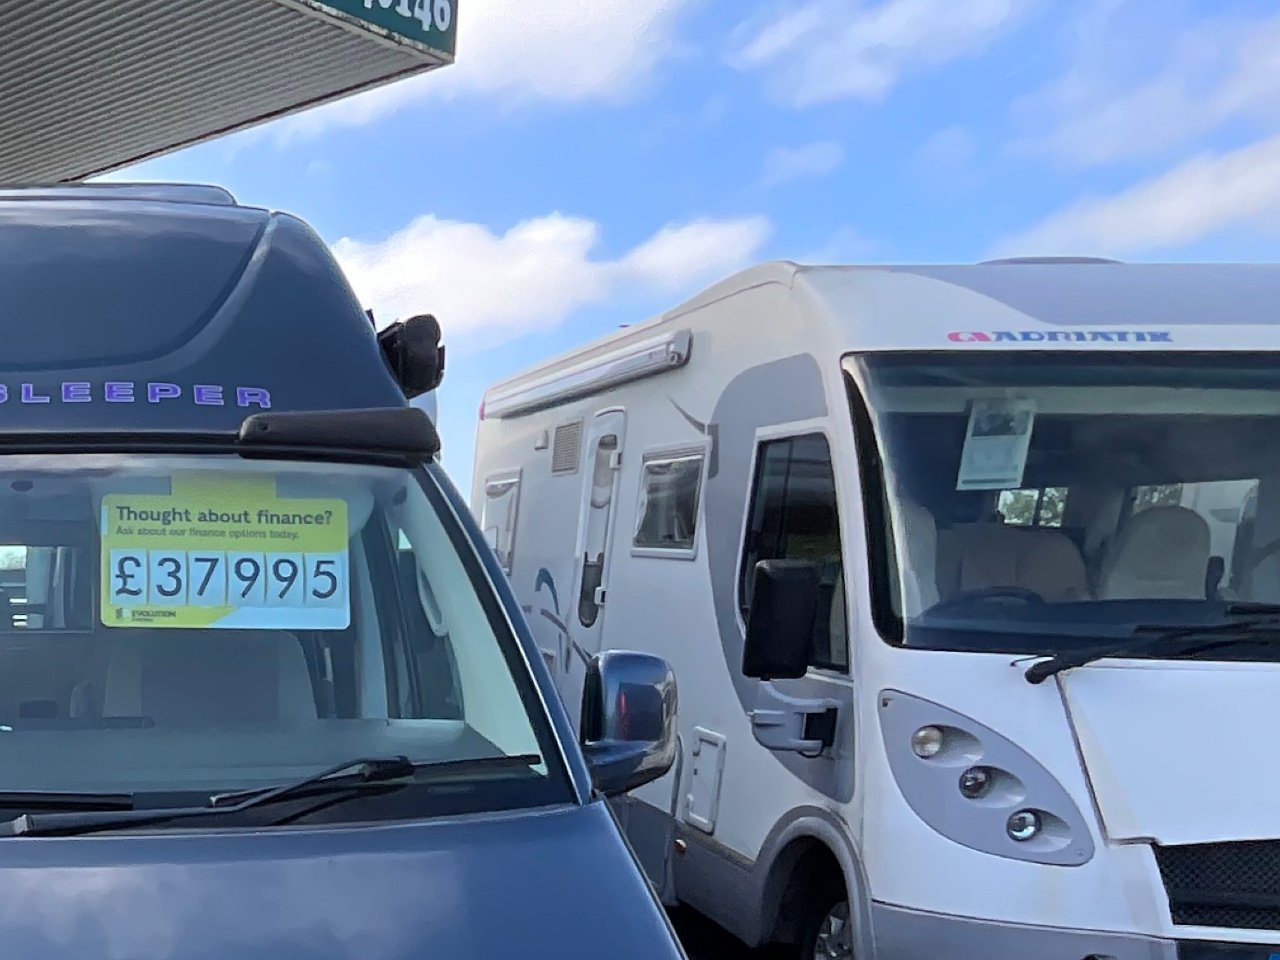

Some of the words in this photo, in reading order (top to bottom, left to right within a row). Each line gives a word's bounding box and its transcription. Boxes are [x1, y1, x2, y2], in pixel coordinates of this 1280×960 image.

[363, 0, 451, 32] 146
[115, 505, 192, 526] Thought
[197, 507, 251, 525] about
[257, 509, 333, 526] finance?
[115, 526, 134, 536] Ask
[137, 526, 167, 537] about
[169, 528, 186, 537] our
[189, 527, 226, 538] finance
[228, 528, 267, 540] options
[115, 555, 338, 600] £37995
